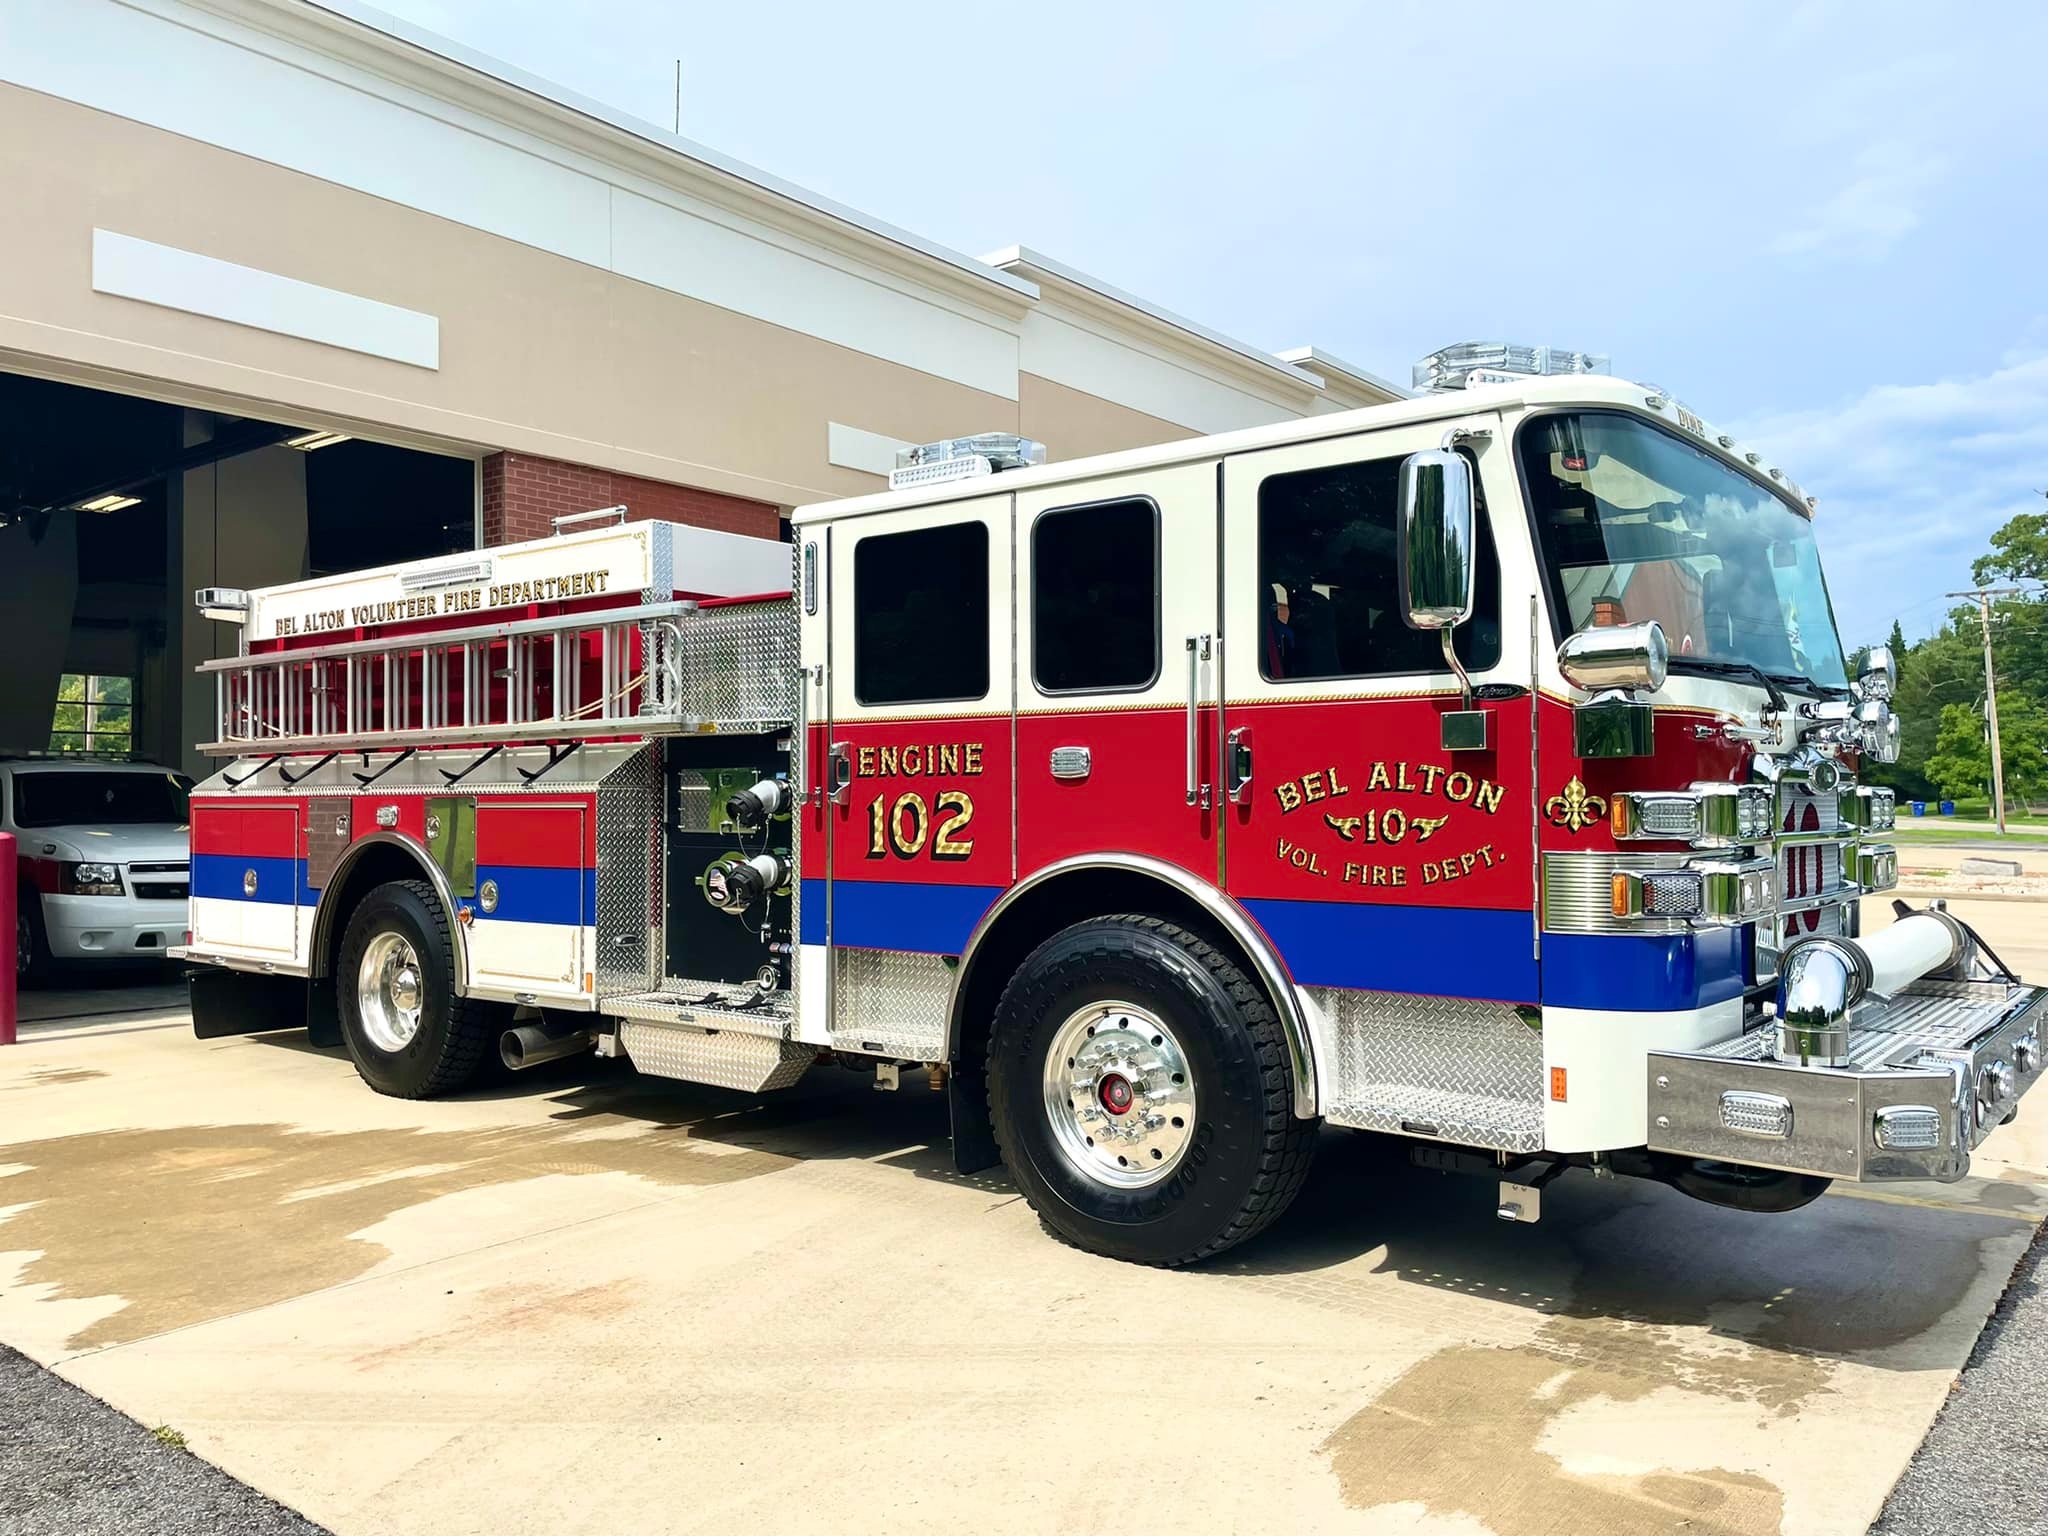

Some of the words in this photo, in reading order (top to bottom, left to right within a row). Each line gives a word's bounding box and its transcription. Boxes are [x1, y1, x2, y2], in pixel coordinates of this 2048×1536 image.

[275, 616, 298, 636] BEL
[303, 609, 346, 633] ALTON
[352, 595, 438, 625] VOLUNTEER
[443, 588, 482, 613] FIRE
[489, 569, 609, 607] DEPARTMENT
[857, 743, 983, 778] ENGINE
[1274, 766, 1349, 815] BEL
[1365, 761, 1507, 815] ALTON
[865, 790, 975, 861] 102
[1363, 808, 1407, 845] 10
[1276, 837, 1328, 877] VOL.
[1343, 862, 1407, 887] FIRE
[1421, 844, 1506, 885] DEPT.
[1783, 800, 1823, 938] 10
